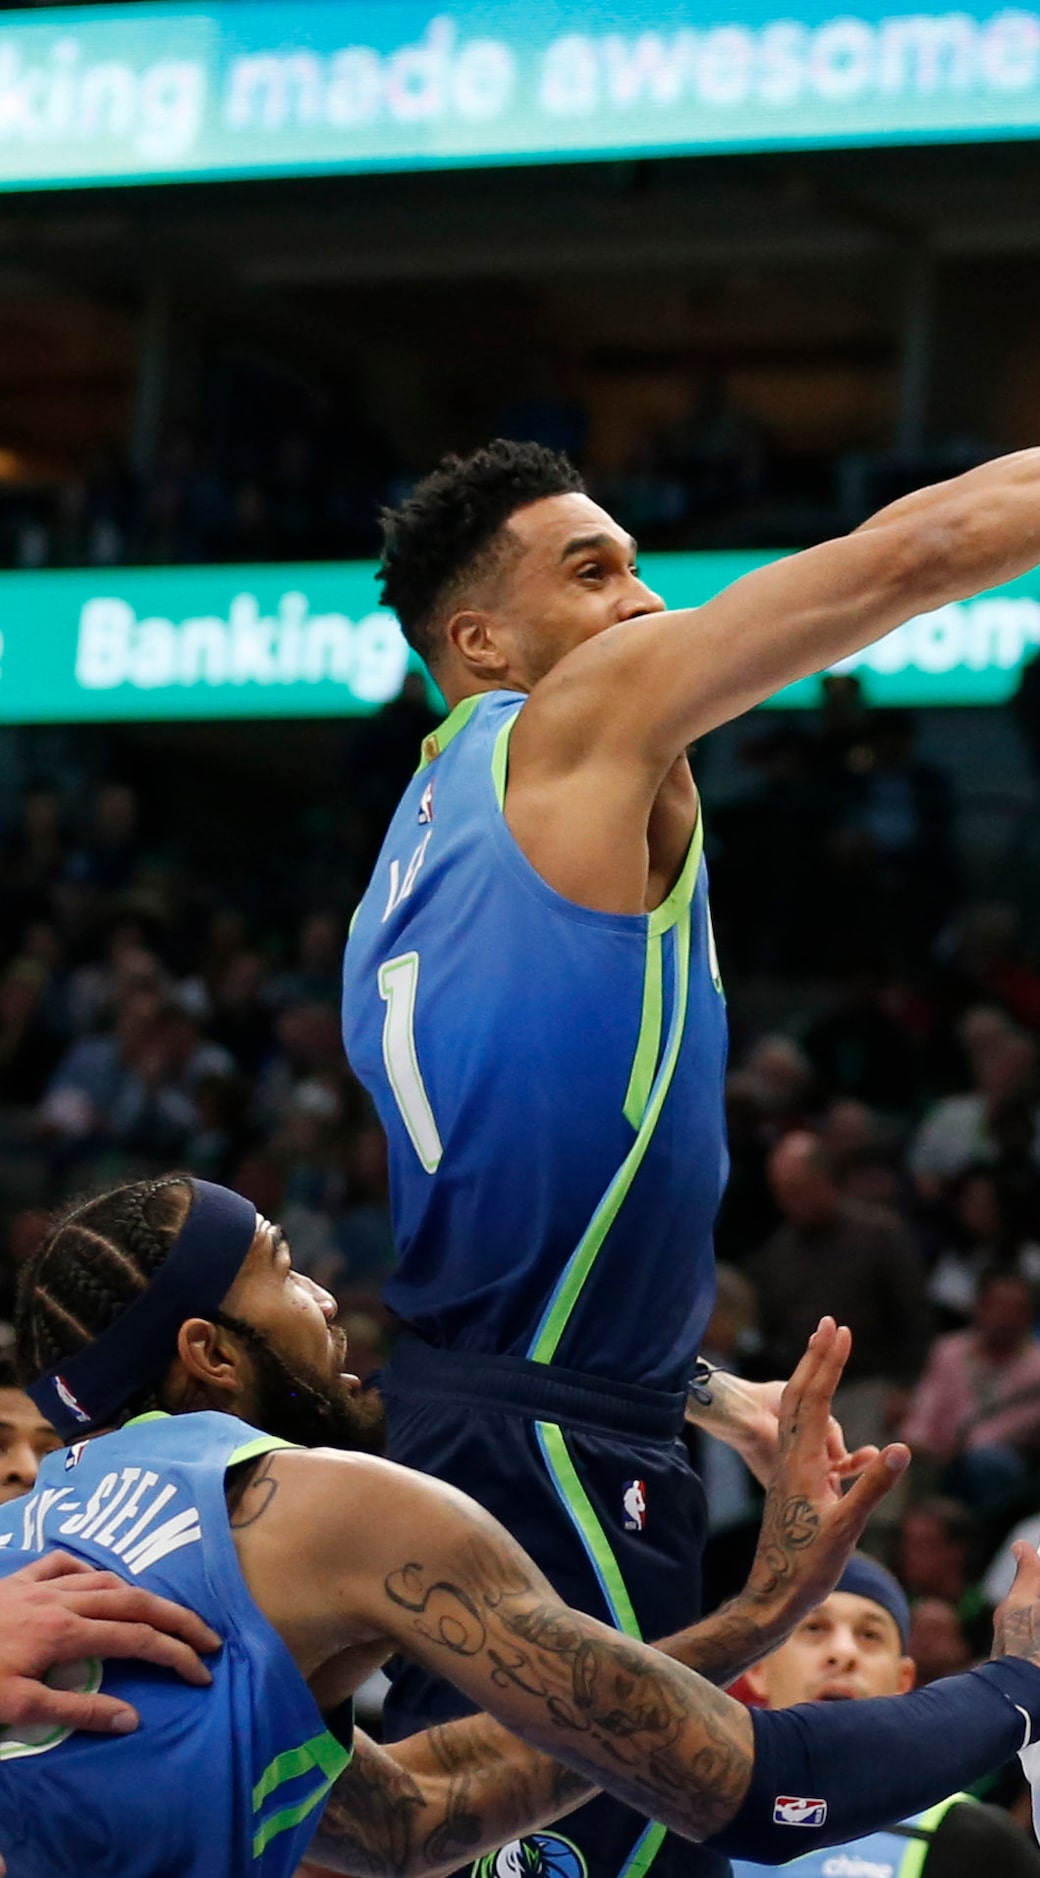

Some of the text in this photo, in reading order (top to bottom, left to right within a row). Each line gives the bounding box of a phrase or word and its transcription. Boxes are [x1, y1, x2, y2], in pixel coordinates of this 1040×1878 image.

[226, 16, 513, 128] made
[75, 591, 409, 702] Banking
[377, 950, 443, 1175] 1
